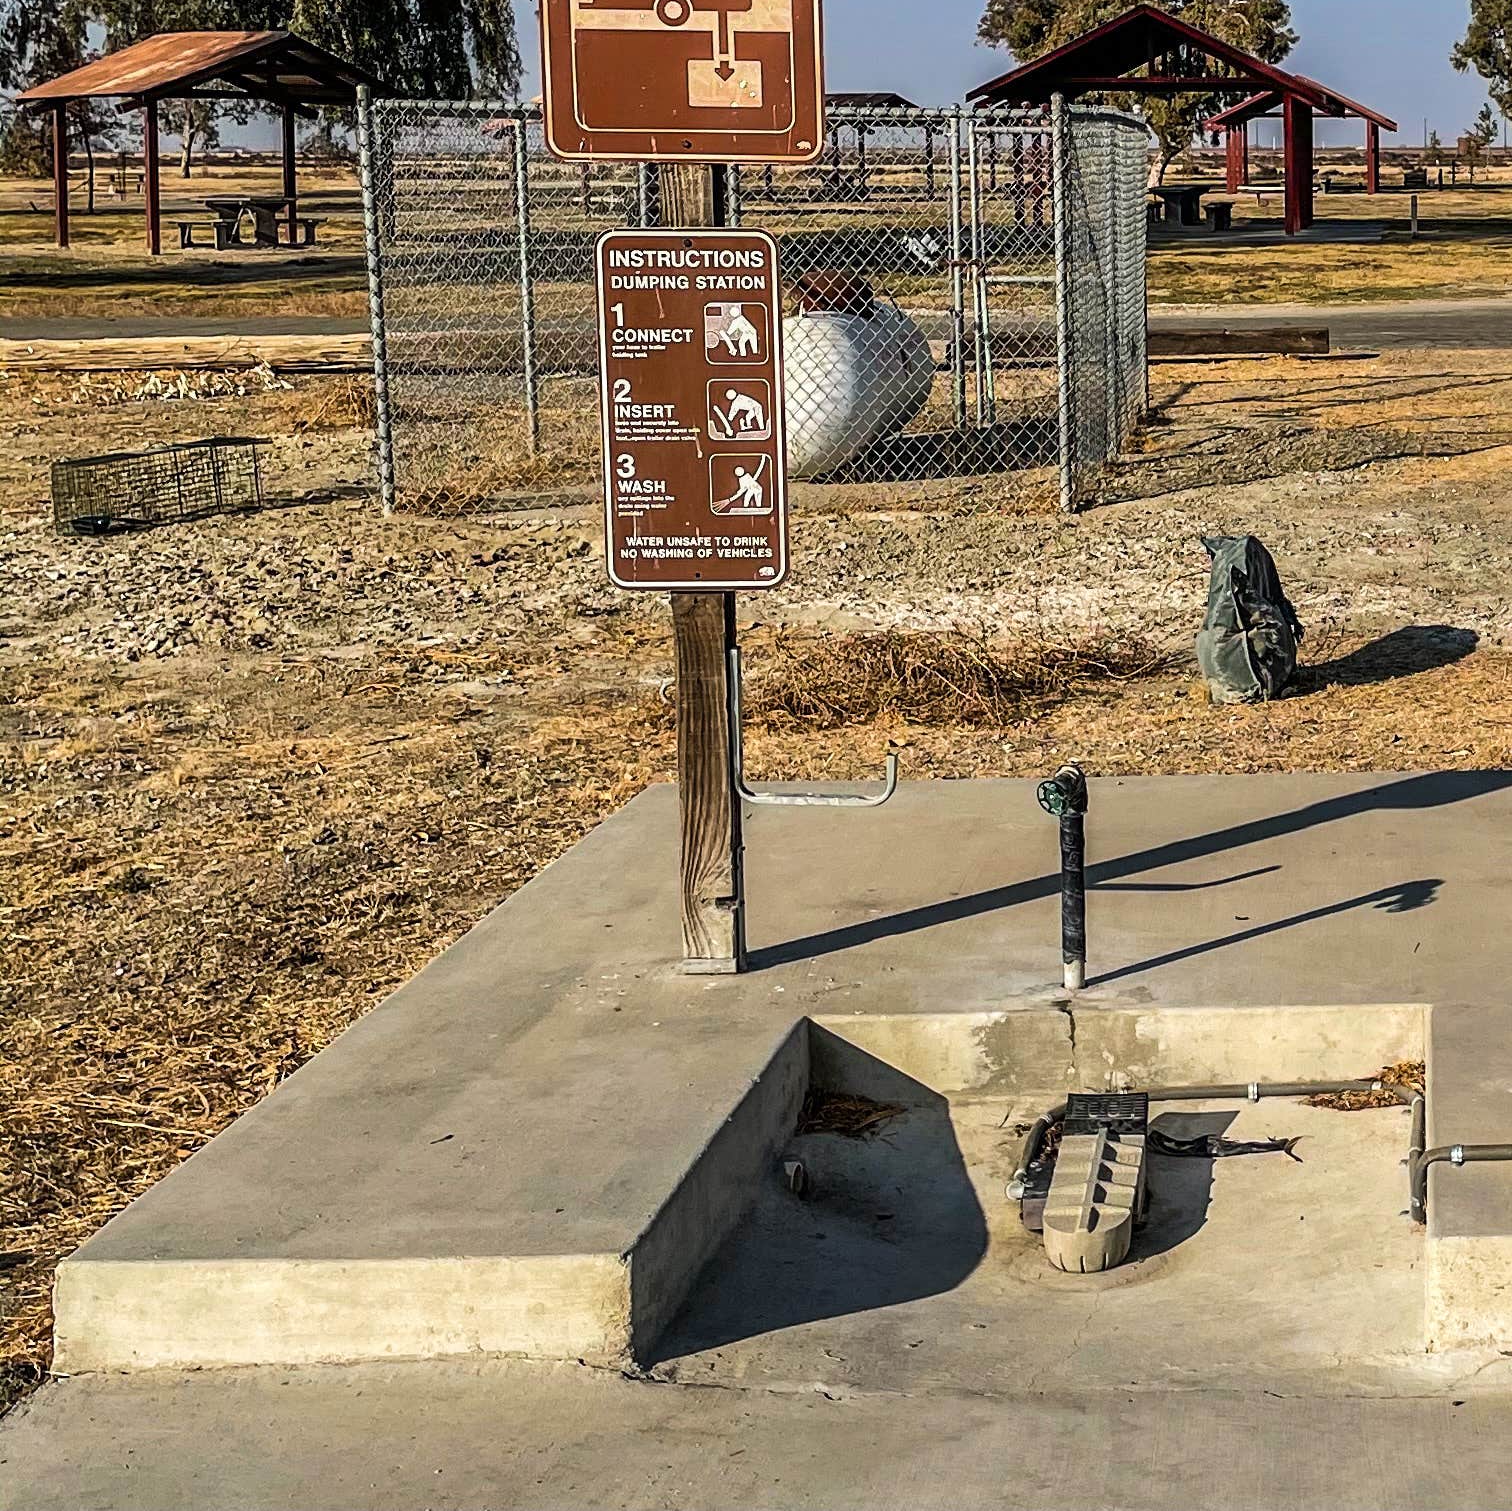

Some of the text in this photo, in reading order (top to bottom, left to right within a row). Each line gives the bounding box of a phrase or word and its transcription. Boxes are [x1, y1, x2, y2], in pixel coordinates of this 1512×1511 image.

[609, 249, 765, 268] INSTRUCTIONS
[611, 275, 766, 290] DUMPING STATION
[610, 302, 624, 327] 1
[612, 328, 694, 343] CONNECT
[613, 378, 632, 403] 2
[614, 404, 675, 418] INSERT
[616, 453, 635, 479] 3
[617, 480, 666, 494] WASH
[625, 536, 768, 547] WATER UNSAFE TO DRINK
[620, 548, 773, 559] NO WASHING OF VEHICLES
